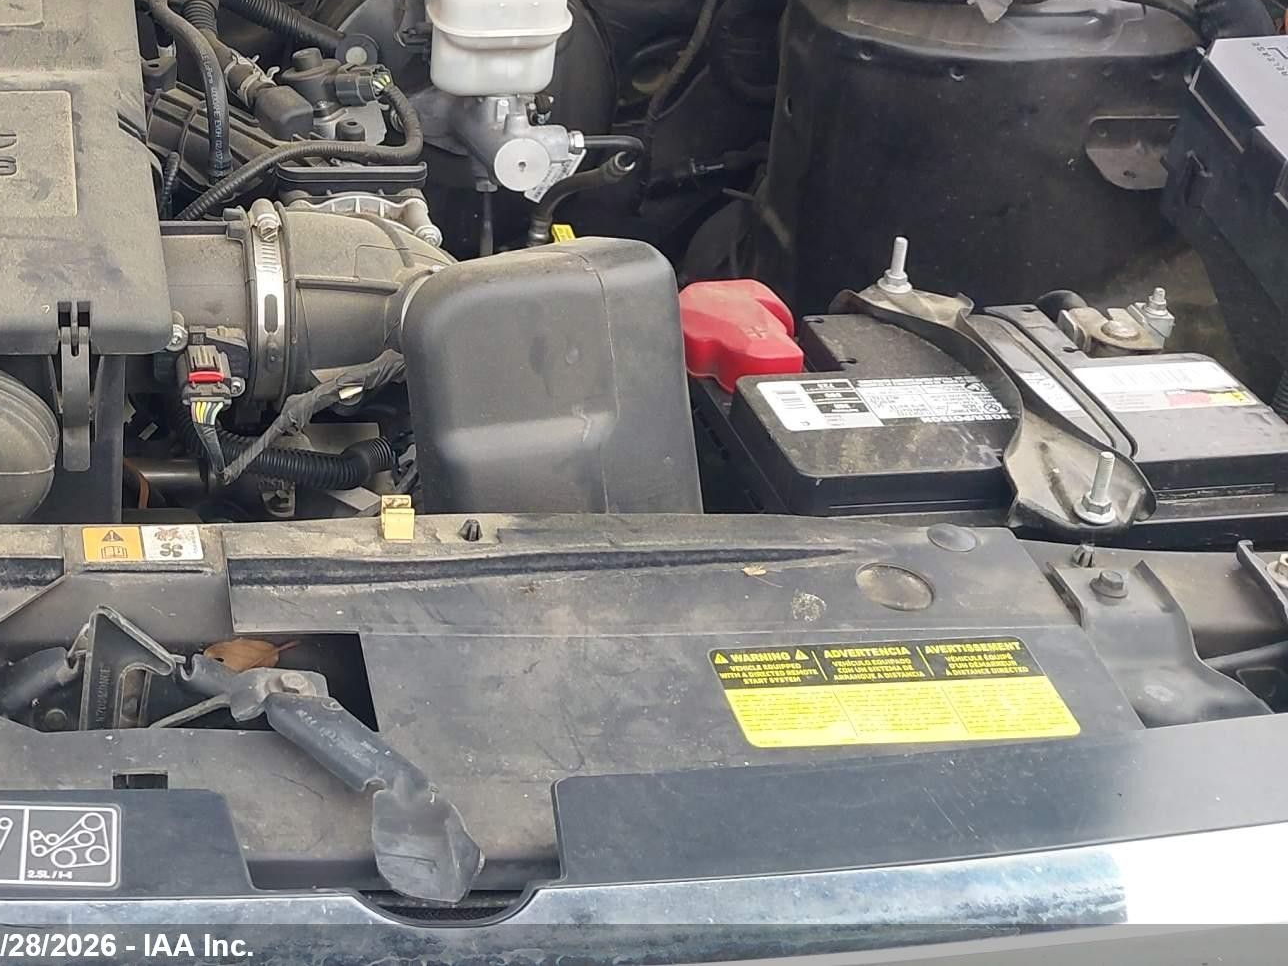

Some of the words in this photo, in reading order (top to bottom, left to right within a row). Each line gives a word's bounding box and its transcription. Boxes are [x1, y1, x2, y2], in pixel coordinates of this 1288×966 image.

[824, 647, 911, 658] ADVERTENCIA
[925, 642, 1020, 654] AVERTISSEMENT
[730, 652, 790, 662] WARNING
[27, 870, 50, 878] 2.5L
